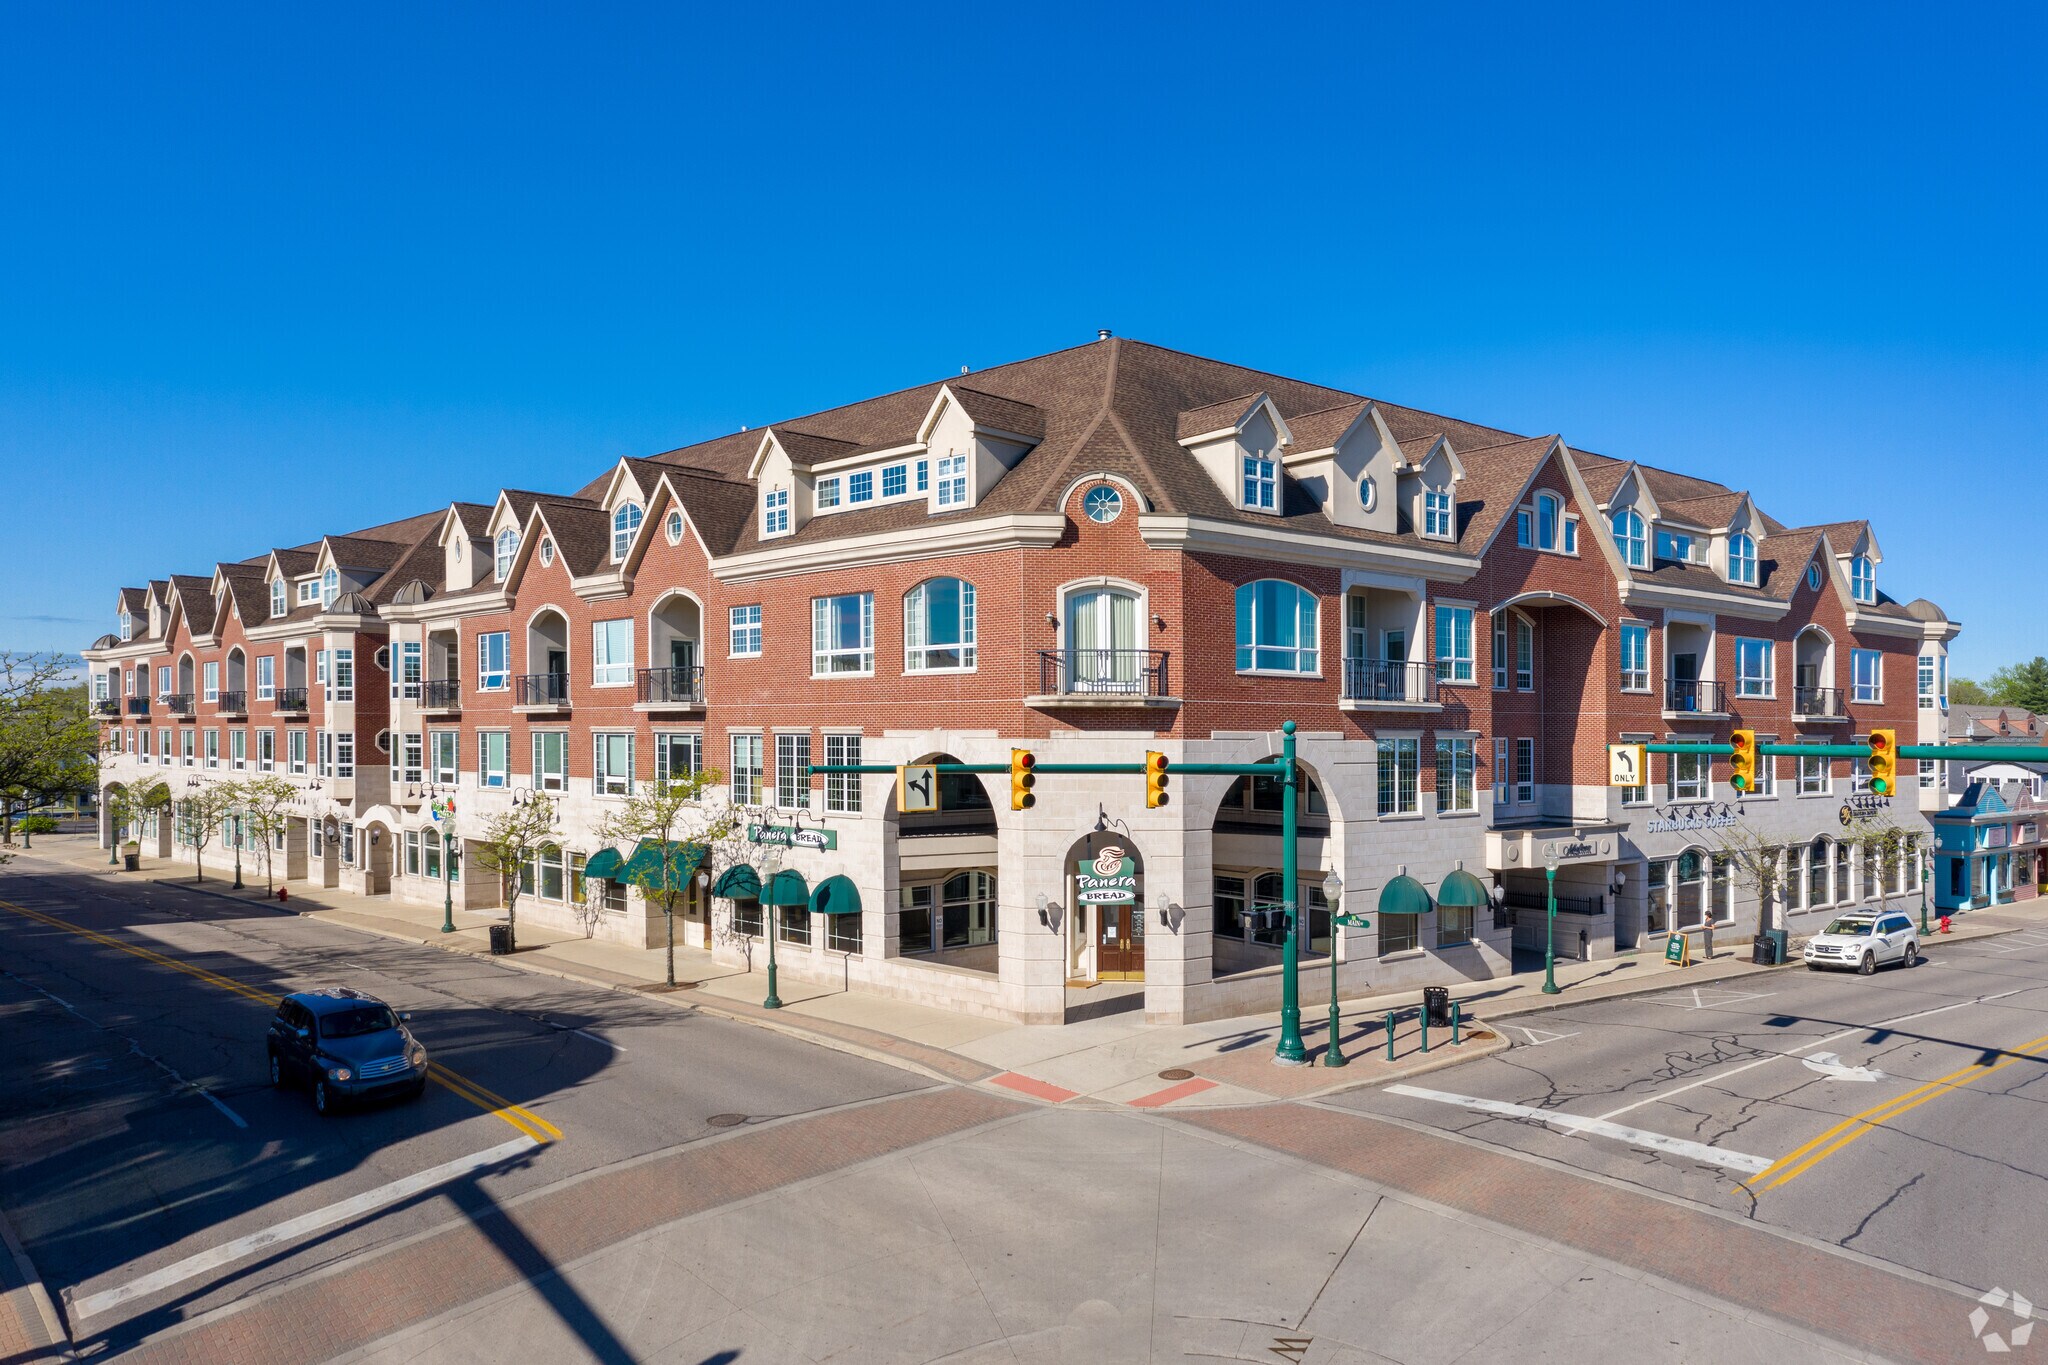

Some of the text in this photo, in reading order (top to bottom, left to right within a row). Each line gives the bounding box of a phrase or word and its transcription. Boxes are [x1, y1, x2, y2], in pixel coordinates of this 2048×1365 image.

[1614, 774, 1636, 782] ONLY
[1647, 815, 1737, 834] STARBUCKS COFFEE
[753, 825, 823, 843] Panera BREAD
[1075, 874, 1137, 889] Panera
[1086, 892, 1127, 900] BREAD
[1347, 919, 1361, 927] MAIN
